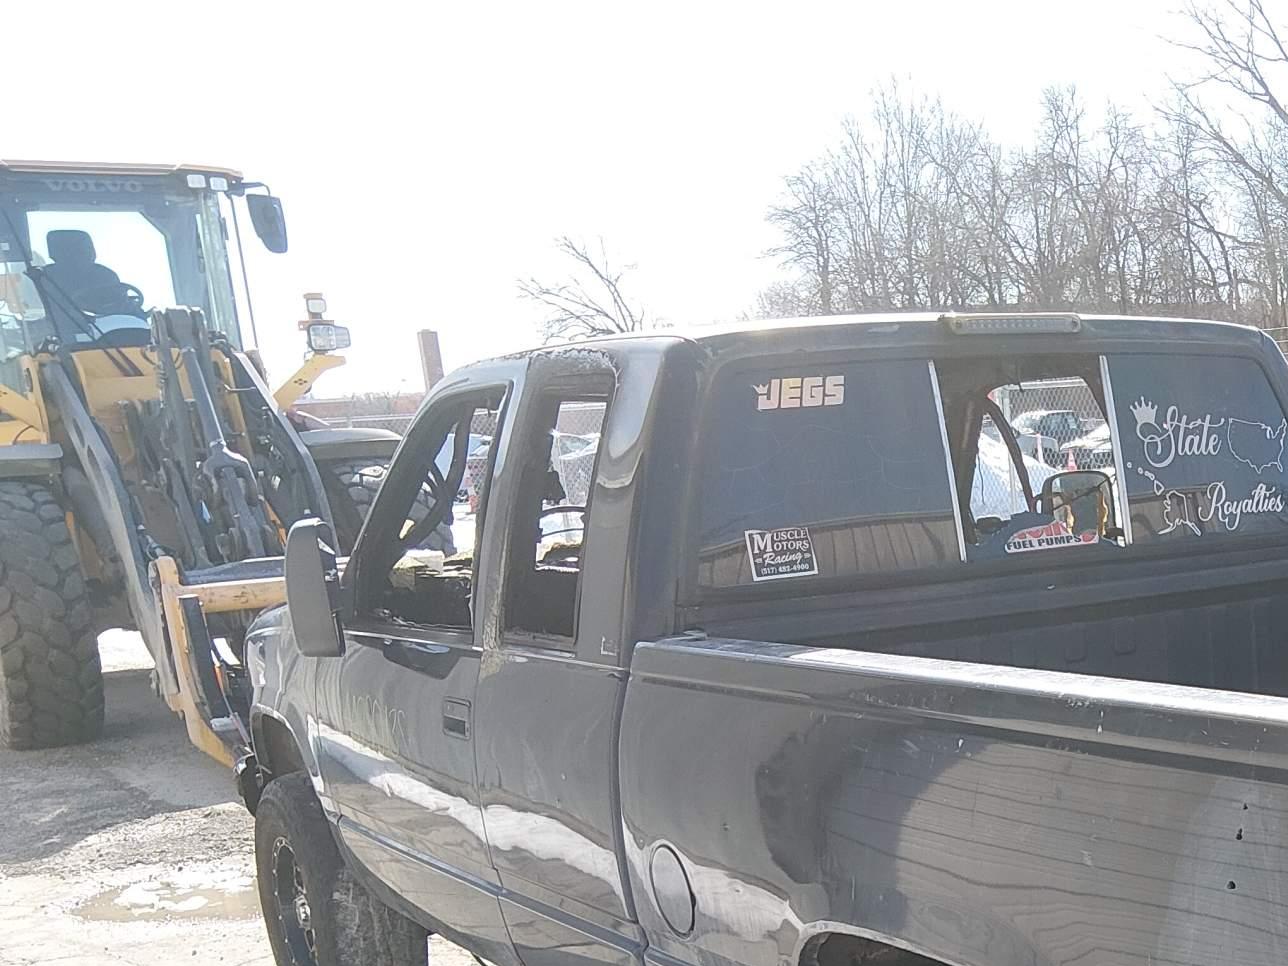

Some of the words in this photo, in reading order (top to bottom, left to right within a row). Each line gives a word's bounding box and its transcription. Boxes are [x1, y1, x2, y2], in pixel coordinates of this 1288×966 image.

[40, 178, 143, 193] VOLVO
[757, 375, 845, 411] JEGS
[1136, 405, 1225, 468] State
[1198, 480, 1286, 531] Royalties
[1006, 540, 1036, 551] FUEL
[1038, 534, 1082, 547] PUMPS
[762, 551, 804, 567] Racing
